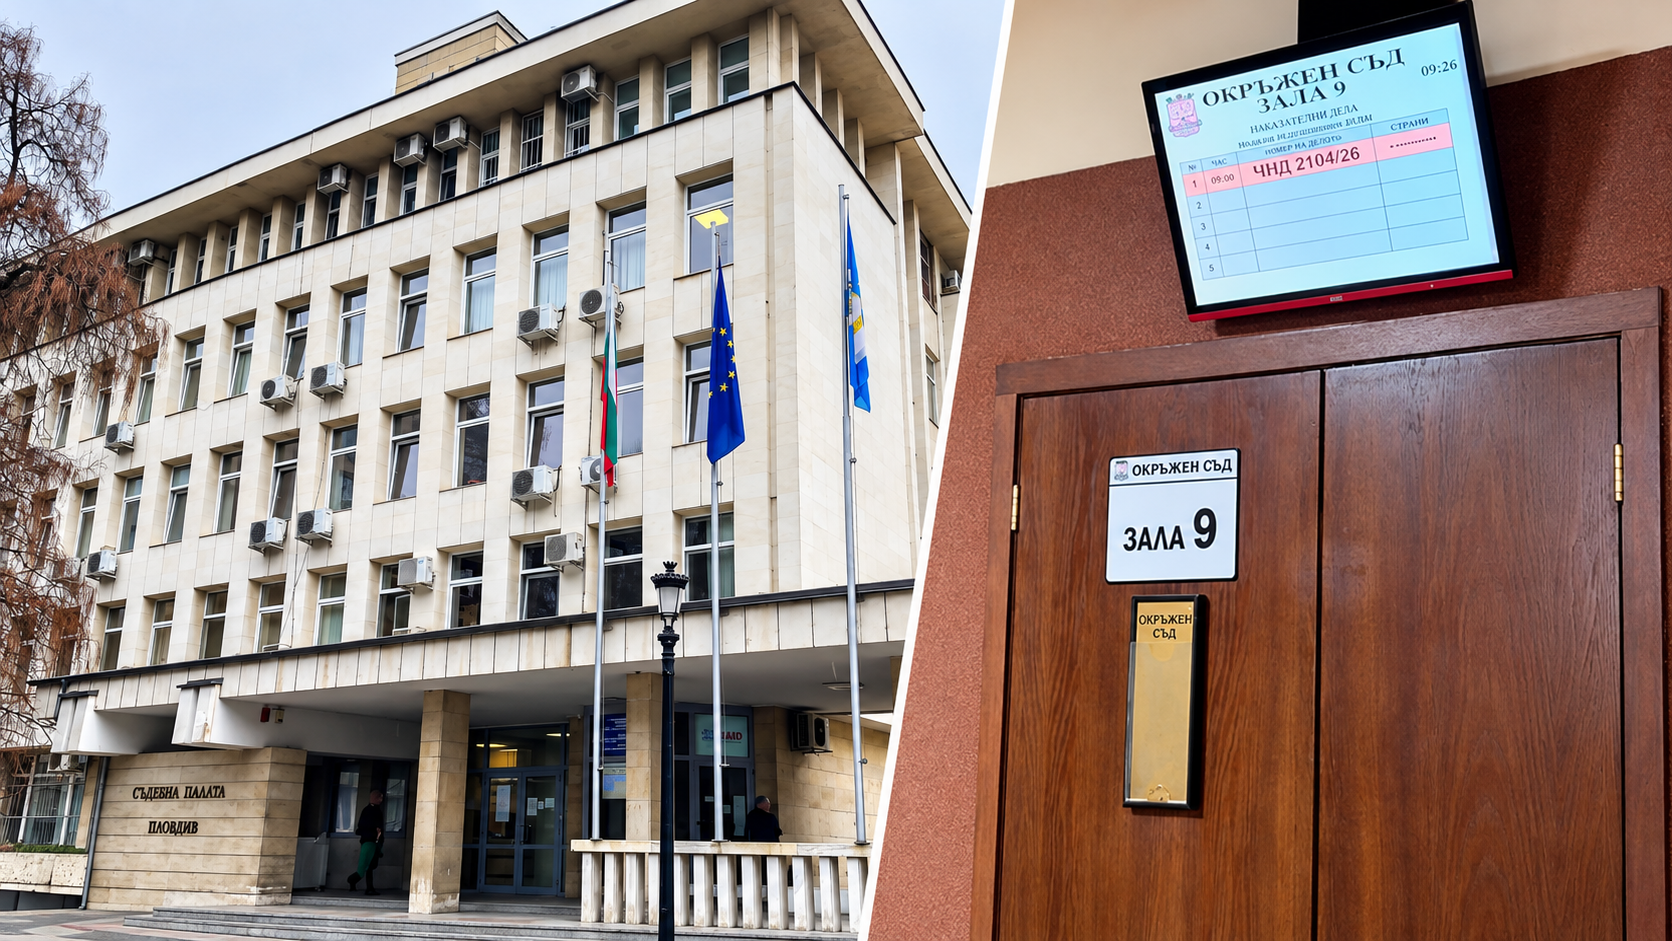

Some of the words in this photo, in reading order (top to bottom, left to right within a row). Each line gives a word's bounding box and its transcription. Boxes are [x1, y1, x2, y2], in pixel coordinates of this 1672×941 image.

[1420, 59, 1458, 77] 09:26
[1202, 62, 1340, 108] ОКРЪЖЕН
[1347, 47, 1405, 75] СЪД
[1257, 89, 1328, 114] ЗАЛА
[1334, 81, 1347, 98] 9
[1390, 117, 1429, 131] СТРАНИ
[1253, 160, 1292, 178] ЧНД
[1295, 146, 1360, 171] 2104/26
[1192, 179, 1197, 188] 1
[1196, 201, 1202, 210] 2
[1200, 222, 1207, 231] 3
[1205, 243, 1211, 251] 4
[1209, 264, 1215, 273] 5
[1132, 461, 1199, 477] ОКРЪЖЕН
[1203, 458, 1233, 474] СЪД
[1123, 525, 1185, 552] ЗАЛА
[1193, 507, 1217, 549] 9
[1139, 614, 1193, 626] ОКРЪЖЕН
[1152, 628, 1177, 640] СЪД
[132, 786, 180, 801] СЪДЕБНА
[183, 785, 226, 799] ПАЛАТА
[148, 820, 199, 836] ПЛОВДИВ
